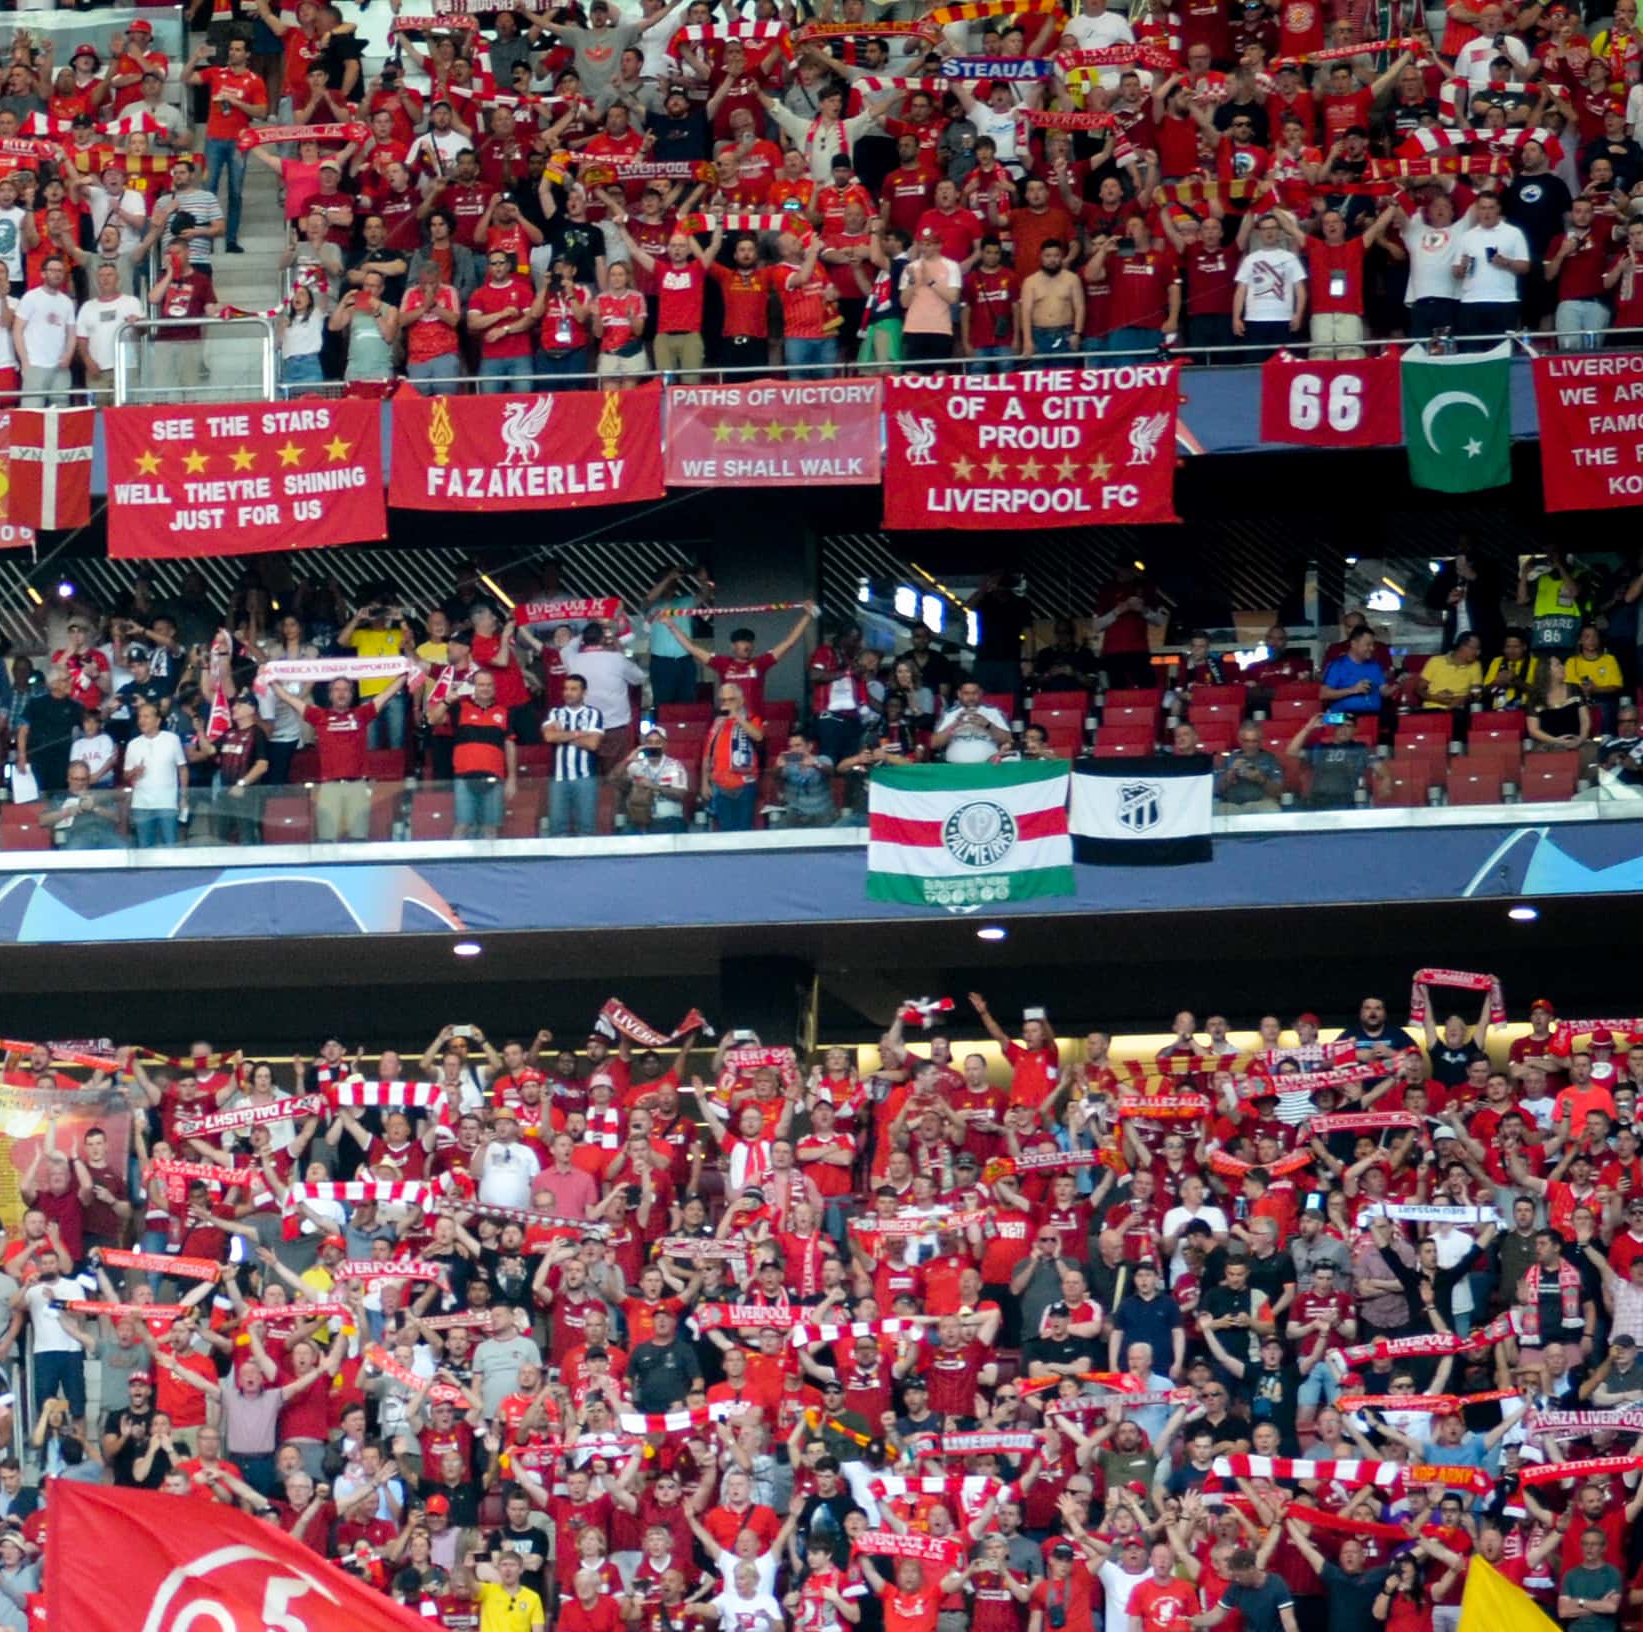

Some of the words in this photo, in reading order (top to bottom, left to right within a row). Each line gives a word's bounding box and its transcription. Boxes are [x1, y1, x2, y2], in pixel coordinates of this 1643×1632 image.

[943, 58, 1036, 80] STEAUA
[617, 160, 691, 176] LIVERPOOL
[673, 386, 741, 407] PATHS
[747, 386, 778, 406] OF
[780, 384, 876, 406] VICTORY
[947, 396, 985, 419] OF
[1002, 397, 1025, 419] A
[1042, 395, 1111, 420] CITY
[1288, 374, 1362, 431] 66
[152, 419, 195, 442] SEE
[207, 415, 250, 438] THE
[262, 409, 331, 434] STARS
[978, 425, 1080, 450] PROUD
[682, 457, 719, 478] WE
[725, 457, 793, 478] SHALL
[799, 455, 863, 477] WALK
[1571, 446, 1619, 467] THE
[426, 459, 626, 499] FAZAKERLEY
[927, 487, 1091, 513] LIVERPOOL
[1101, 485, 1139, 508] FC
[170, 506, 229, 533] JUST
[238, 504, 280, 527] FOR
[293, 501, 323, 523] US
[729, 1305, 792, 1320] LIVERPOOL
[1386, 1334, 1456, 1350] LIVERPOOL
